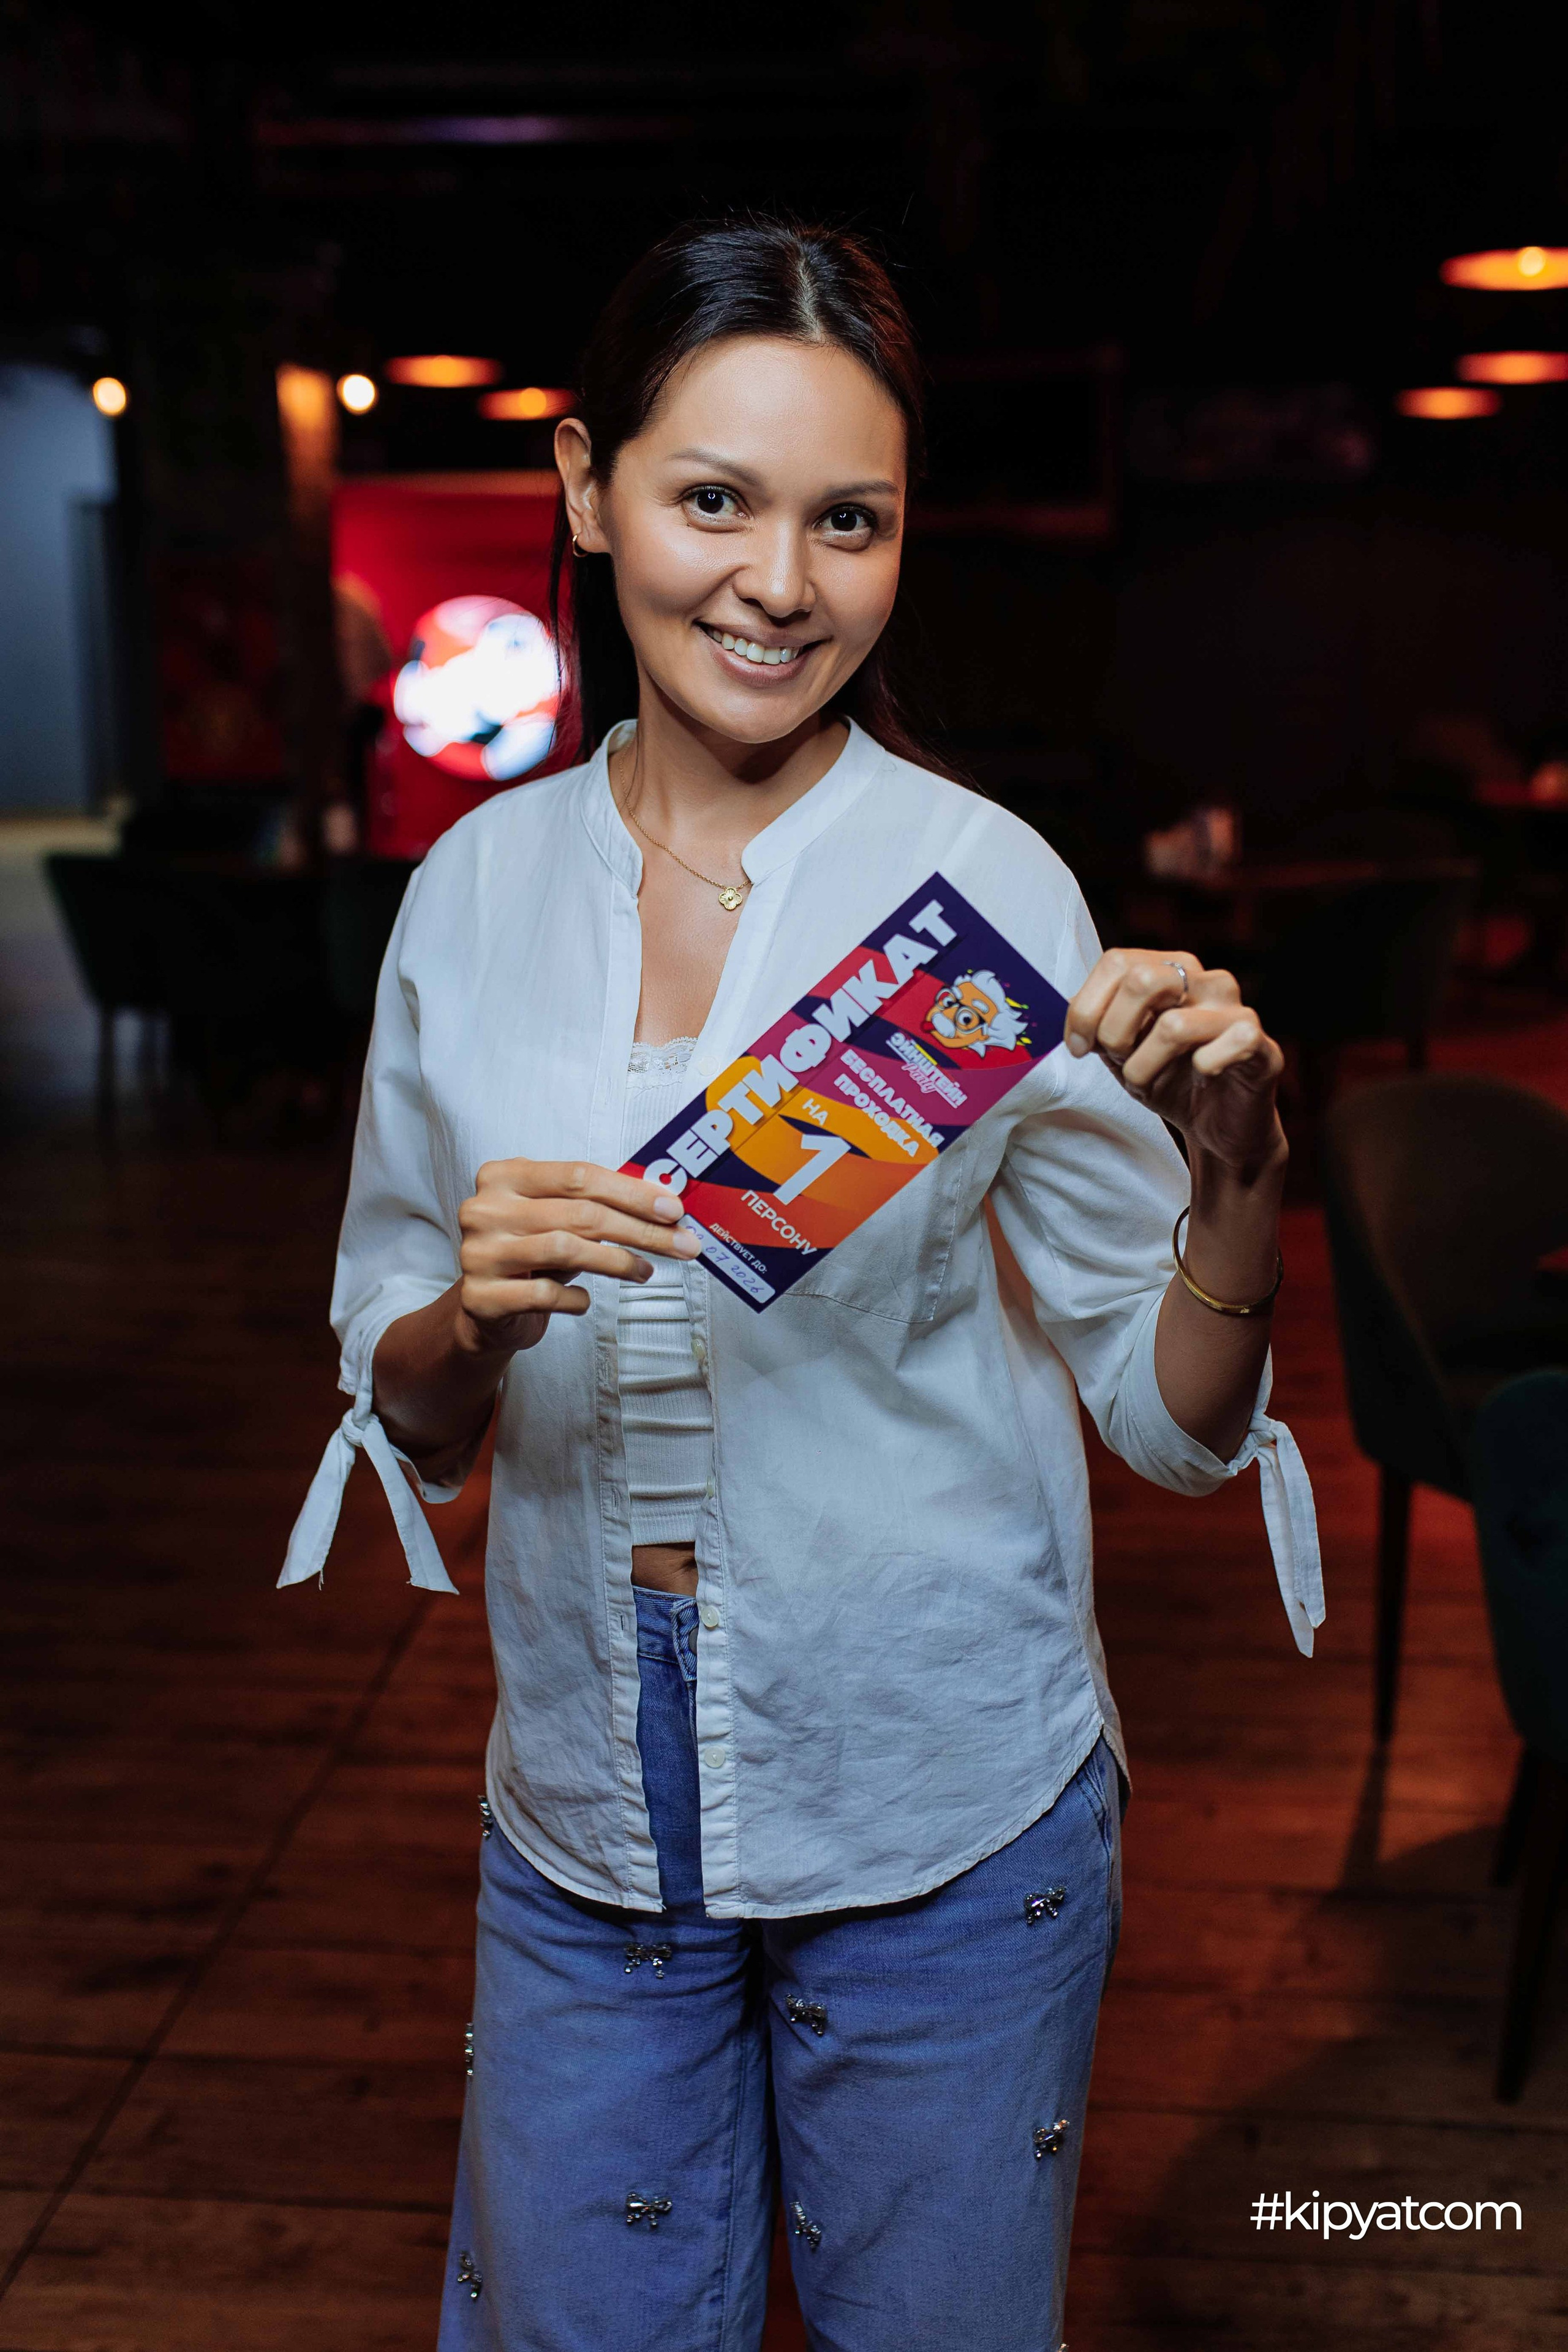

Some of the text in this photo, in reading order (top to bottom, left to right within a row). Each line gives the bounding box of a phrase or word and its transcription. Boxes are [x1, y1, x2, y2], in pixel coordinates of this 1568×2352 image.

[643, 899, 957, 1196] СЕРТИФИКАТ
[890, 1032, 967, 1106] ЭЙНШТЕЙН
[901, 1062, 937, 1093] Party
[802, 1098, 829, 1126] НА
[834, 1073, 919, 1158] ПРОХОДКА
[840, 1049, 945, 1148] БЕСПЛАТНАЯ
[773, 1134, 851, 1205] 1
[709, 1223, 755, 1263] ДЕЙСТВУЕТ
[751, 1259, 767, 1274] ДО:
[741, 1189, 817, 1256] ПЕРСОНУ
